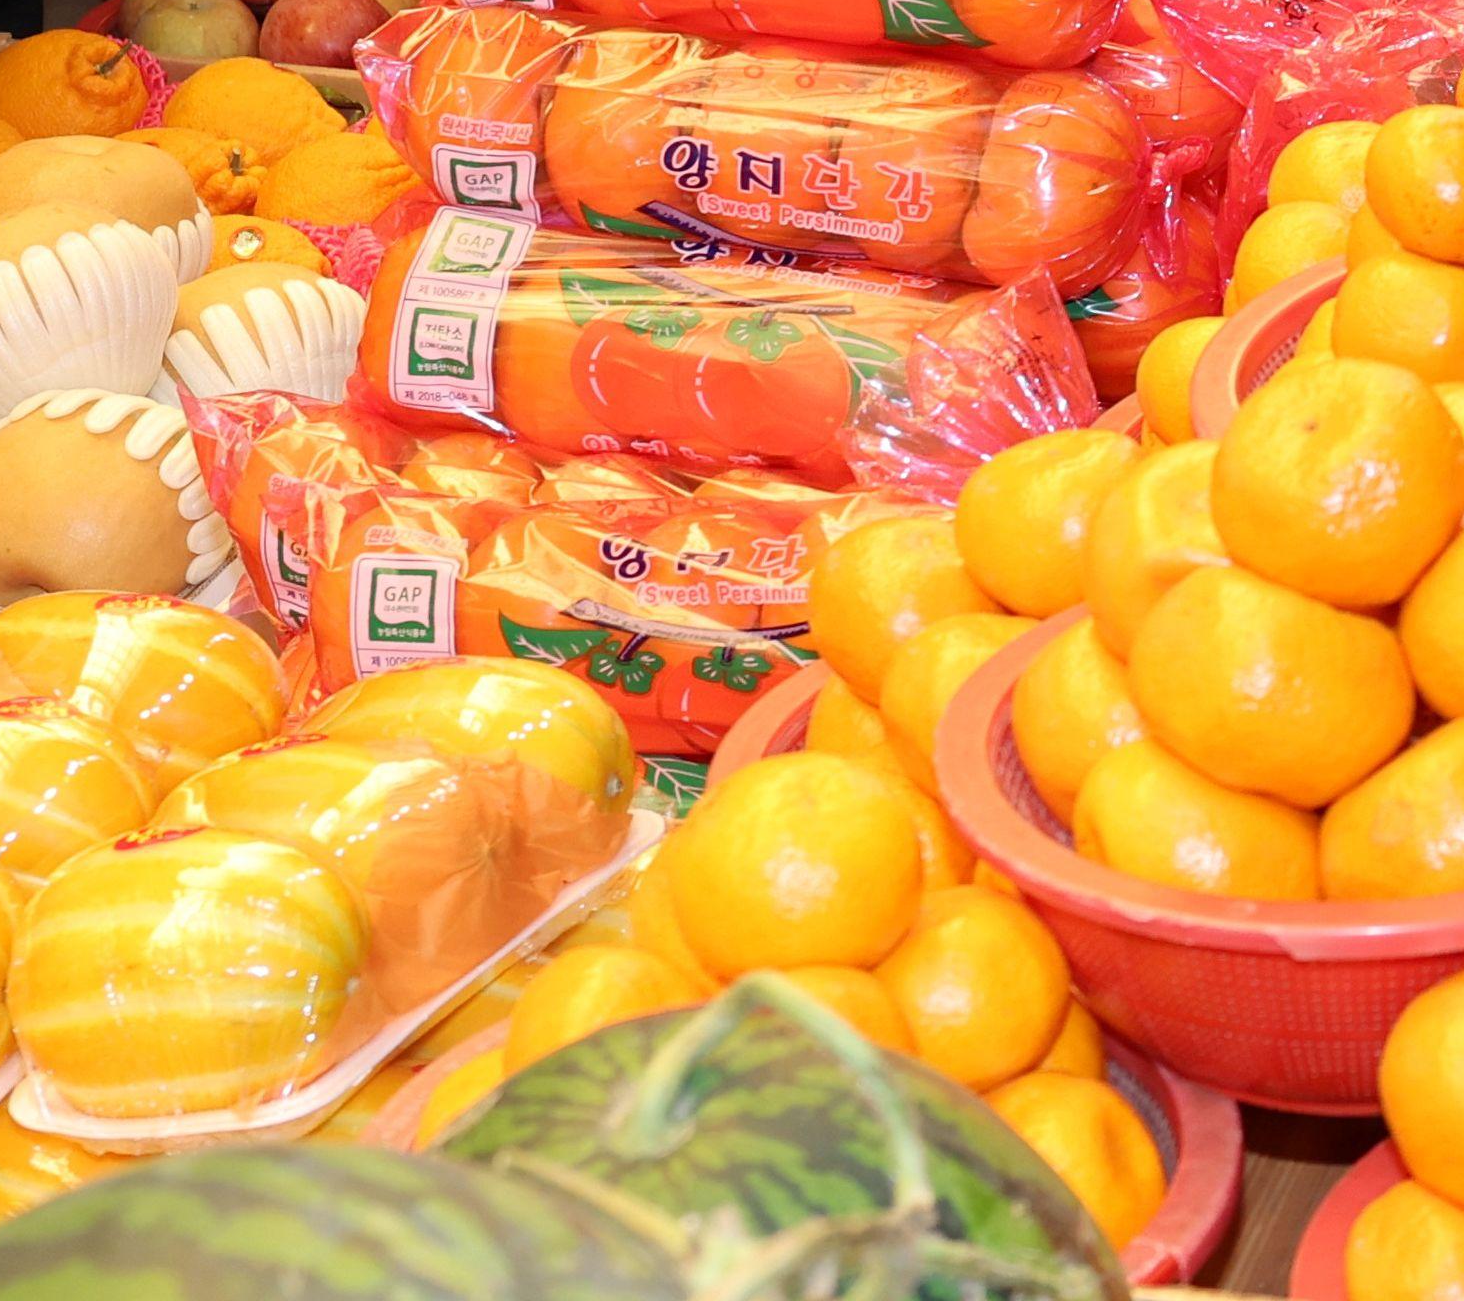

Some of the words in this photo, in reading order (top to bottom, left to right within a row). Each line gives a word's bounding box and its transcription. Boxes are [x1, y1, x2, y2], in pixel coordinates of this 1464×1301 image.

[439, 115, 534, 144] 원산지:국내산
[463, 171, 505, 187] GAP
[696, 195, 772, 224] (Sweet
[778, 206, 905, 246] Persimmon)
[456, 232, 496, 250] GAP
[424, 322, 464, 343] 저탄소
[383, 585, 423, 603] GAP
[636, 583, 709, 605] (Sweet
[370, 655, 382, 668] 제
